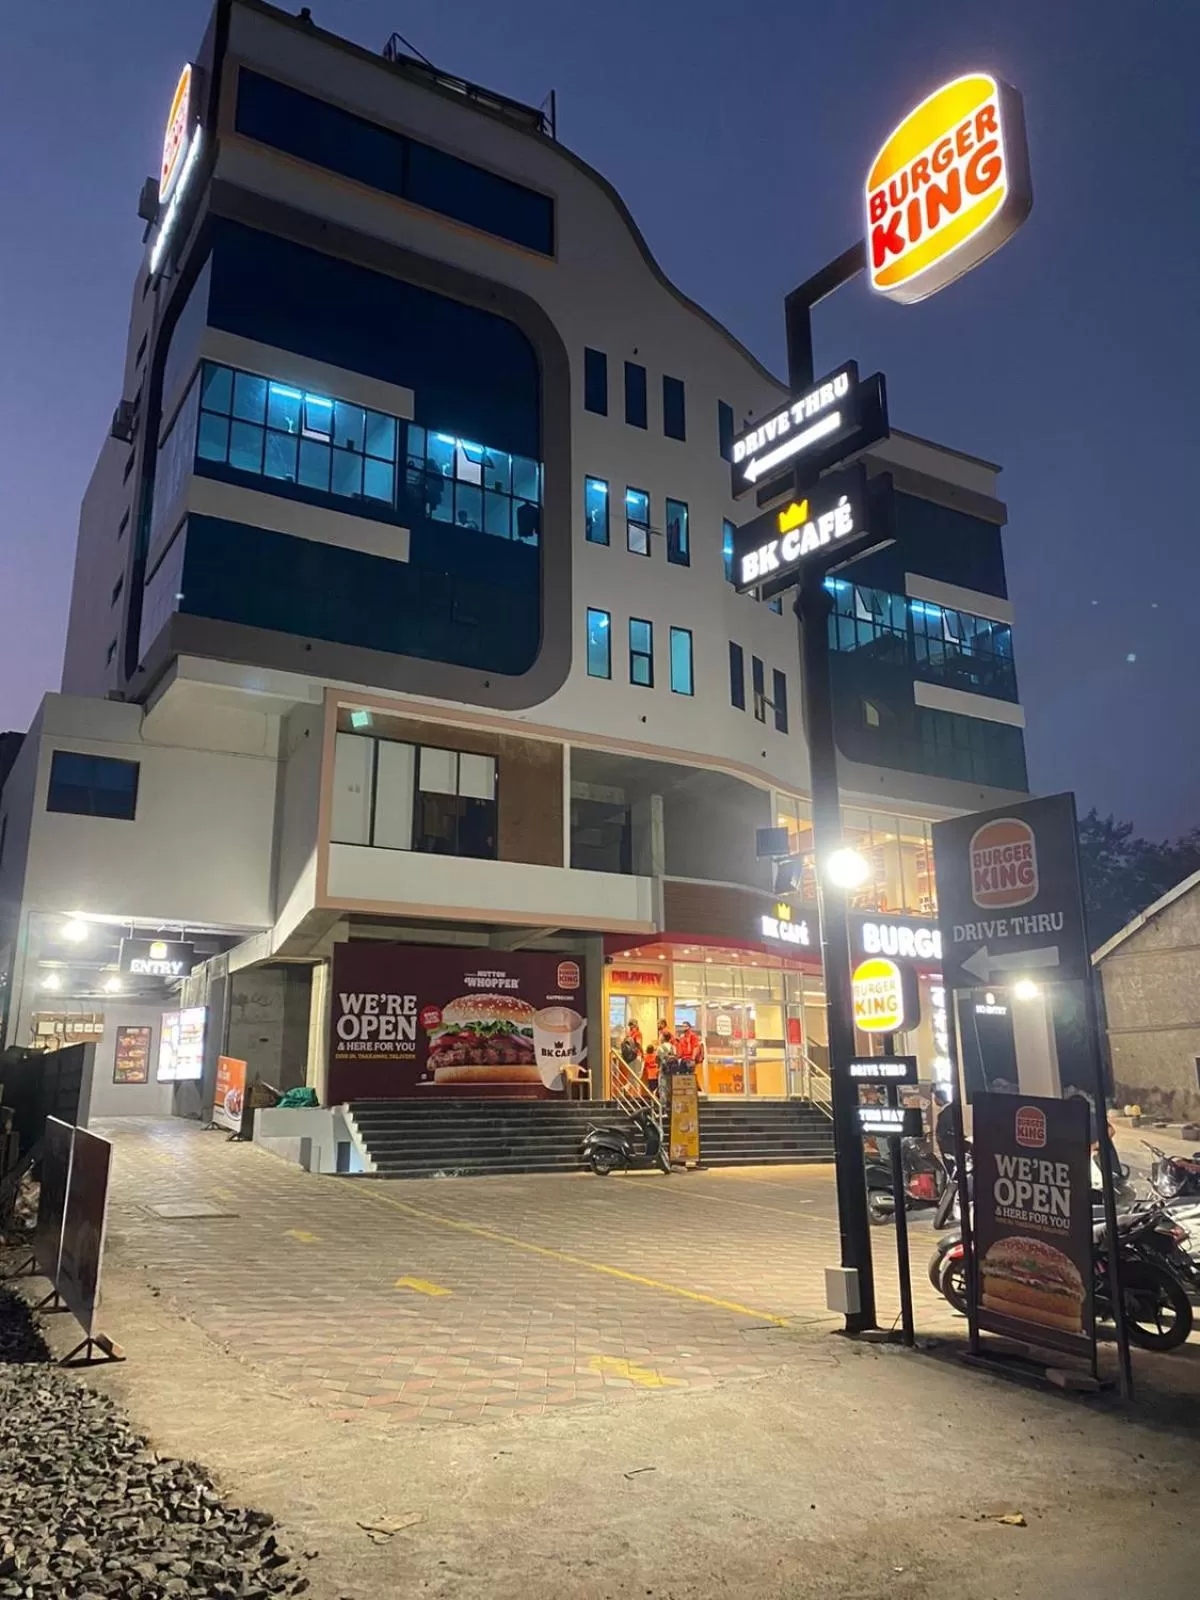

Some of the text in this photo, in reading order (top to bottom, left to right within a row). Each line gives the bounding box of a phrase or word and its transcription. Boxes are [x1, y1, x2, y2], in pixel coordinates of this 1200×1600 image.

[869, 103, 998, 225] BURGER
[872, 139, 1002, 269] KING
[733, 372, 849, 463] DRIVE THRU
[741, 495, 853, 583] BK CAFÉ
[973, 842, 1033, 868] BURGER
[974, 860, 1035, 892] KING
[953, 911, 1064, 942] DRIVE THRU
[130, 959, 184, 975] ENTRY
[611, 970, 663, 984] DELIVERY
[464, 978, 520, 989] WHOPPER
[339, 992, 418, 1015] WE'RE
[855, 994, 898, 1016] KING
[336, 1014, 418, 1041] OPEN
[346, 1041, 373, 1051] HERE
[374, 1041, 394, 1051] FOR
[395, 1042, 416, 1051] YOU
[541, 1048, 554, 1057] BK
[850, 1064, 879, 1076] DRIVE
[1017, 1126, 1045, 1140] KING
[994, 1153, 1071, 1188] WE'RE
[994, 1177, 1071, 1218] OPEN
[1003, 1207, 1028, 1221] HERE
[1028, 1211, 1049, 1226] FOR
[1048, 1215, 1071, 1230] YOU
